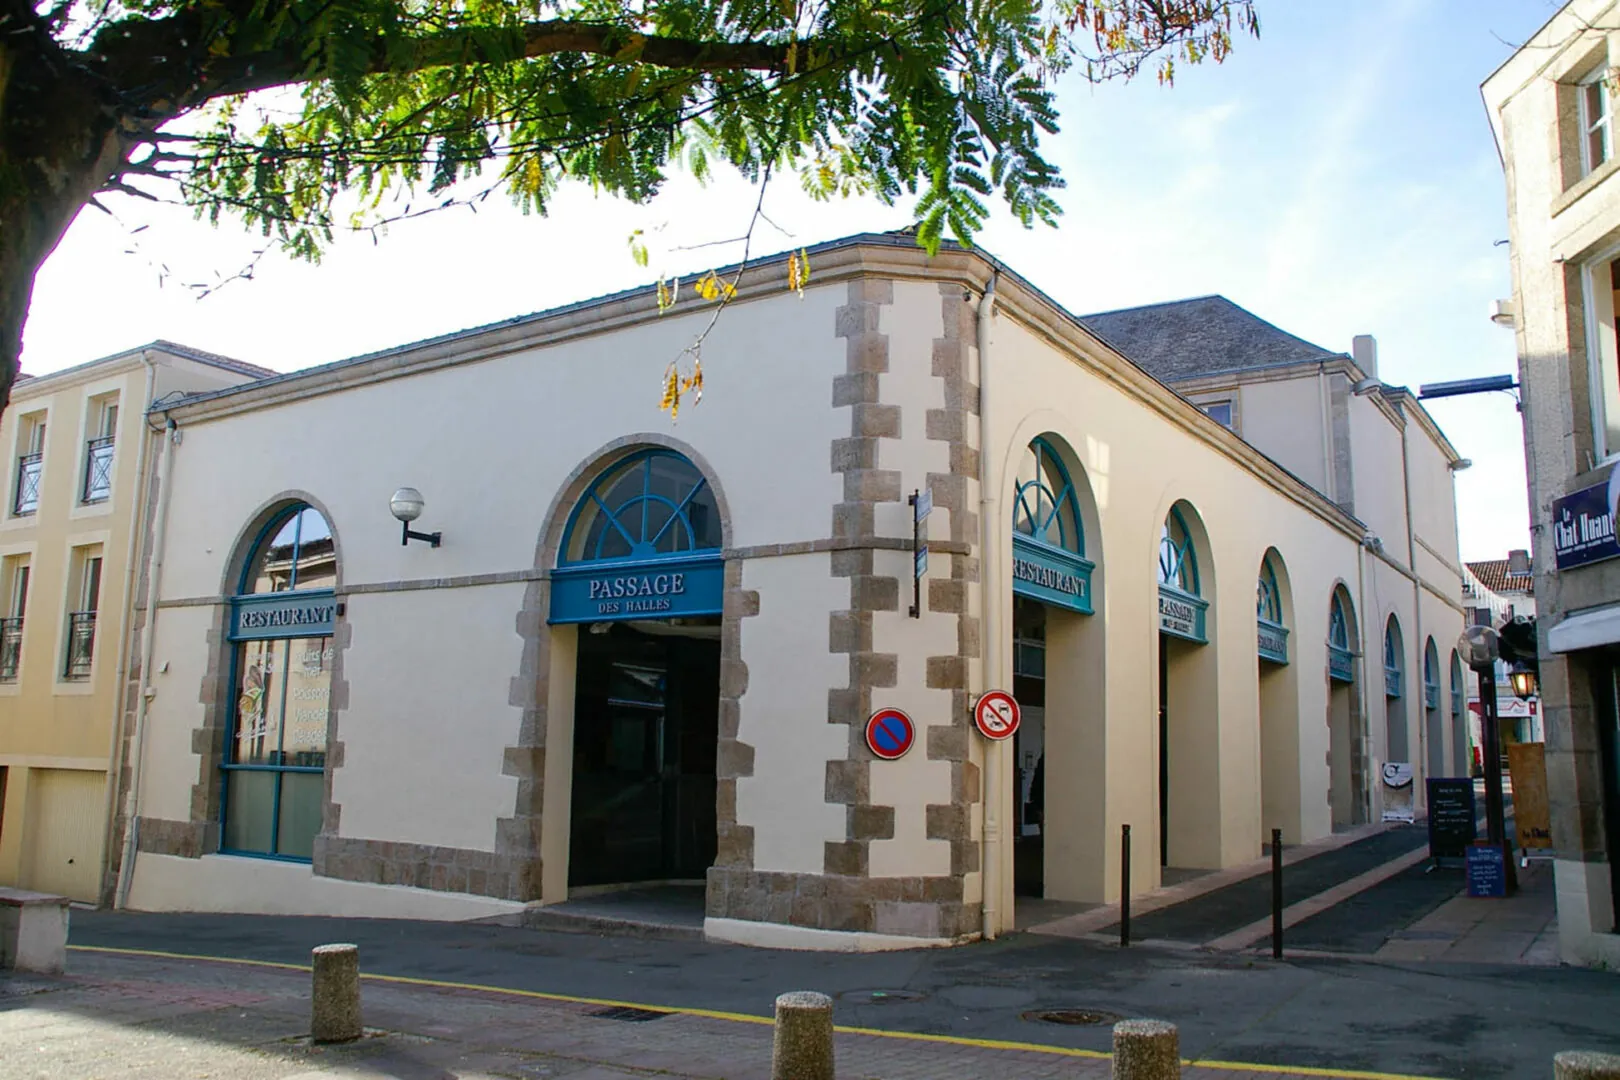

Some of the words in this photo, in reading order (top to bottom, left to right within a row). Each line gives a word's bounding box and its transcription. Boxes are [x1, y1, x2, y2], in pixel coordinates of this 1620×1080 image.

[1554, 519, 1579, 549] Chat
[1580, 512, 1615, 542] Huant
[589, 573, 685, 599] PASSAGE
[239, 606, 333, 628] RESTAURANT
[599, 602, 619, 614] DES
[626, 599, 671, 612] HALLES
[322, 647, 334, 660] de
